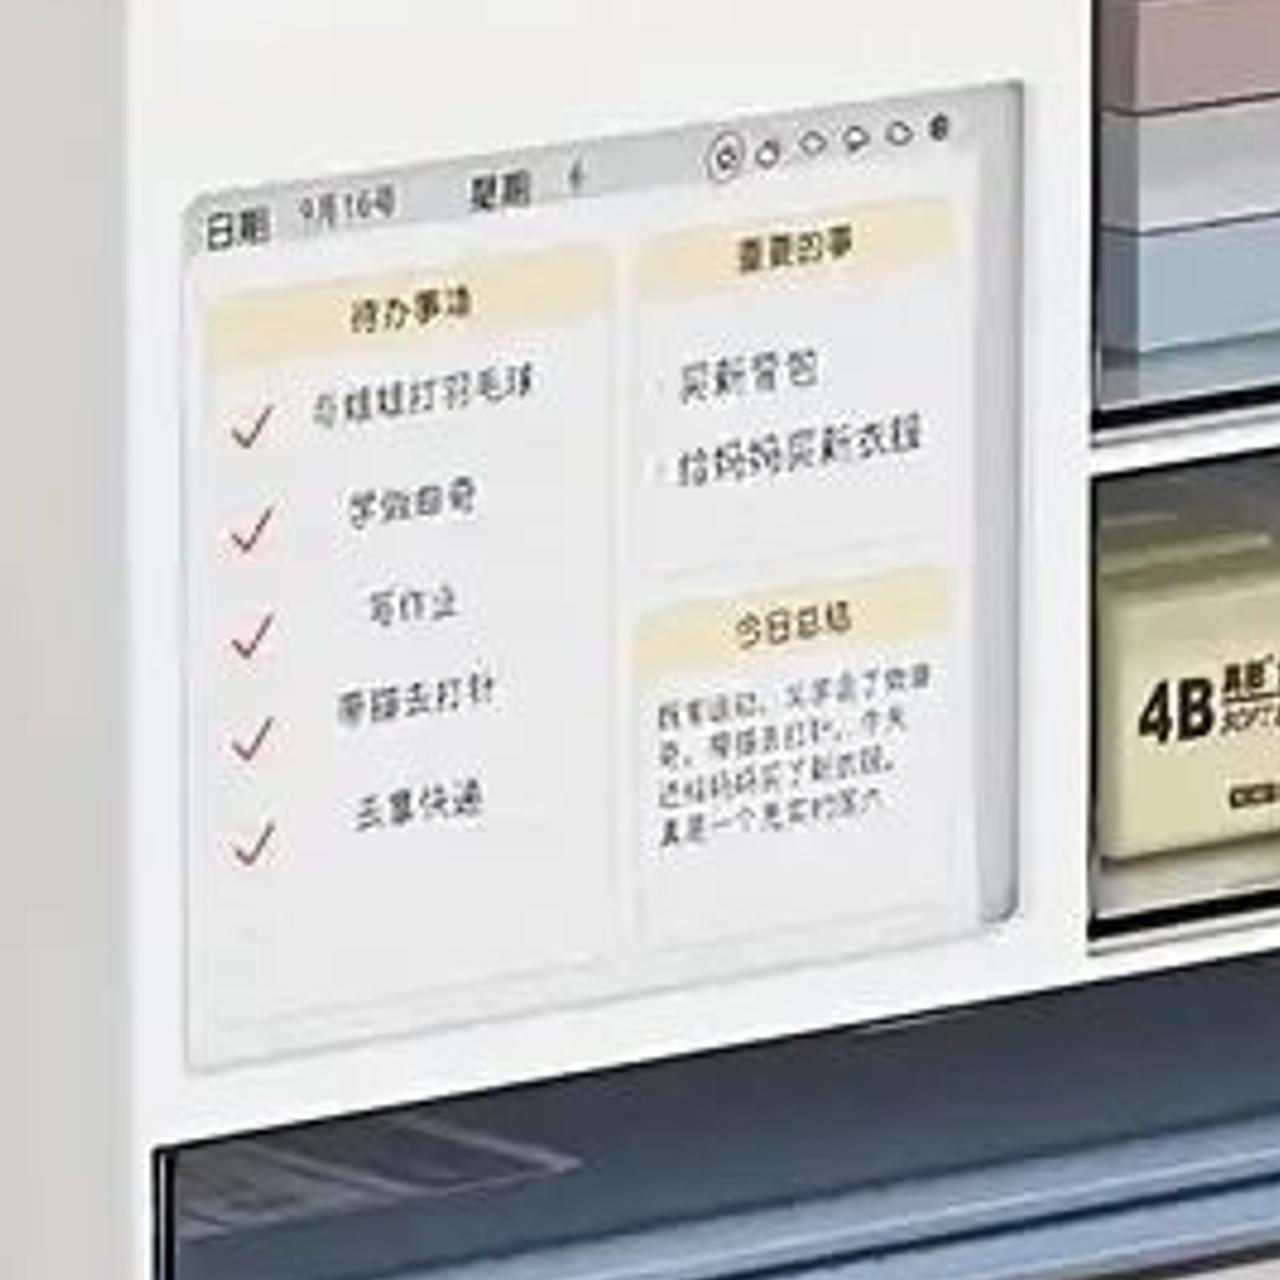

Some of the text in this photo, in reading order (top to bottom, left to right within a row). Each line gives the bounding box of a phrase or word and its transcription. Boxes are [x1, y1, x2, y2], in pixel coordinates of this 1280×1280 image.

[206, 204, 272, 252] 日期
[470, 168, 533, 212] 星期
[738, 223, 854, 274] 重要的事
[1137, 677, 1216, 745] 4B
